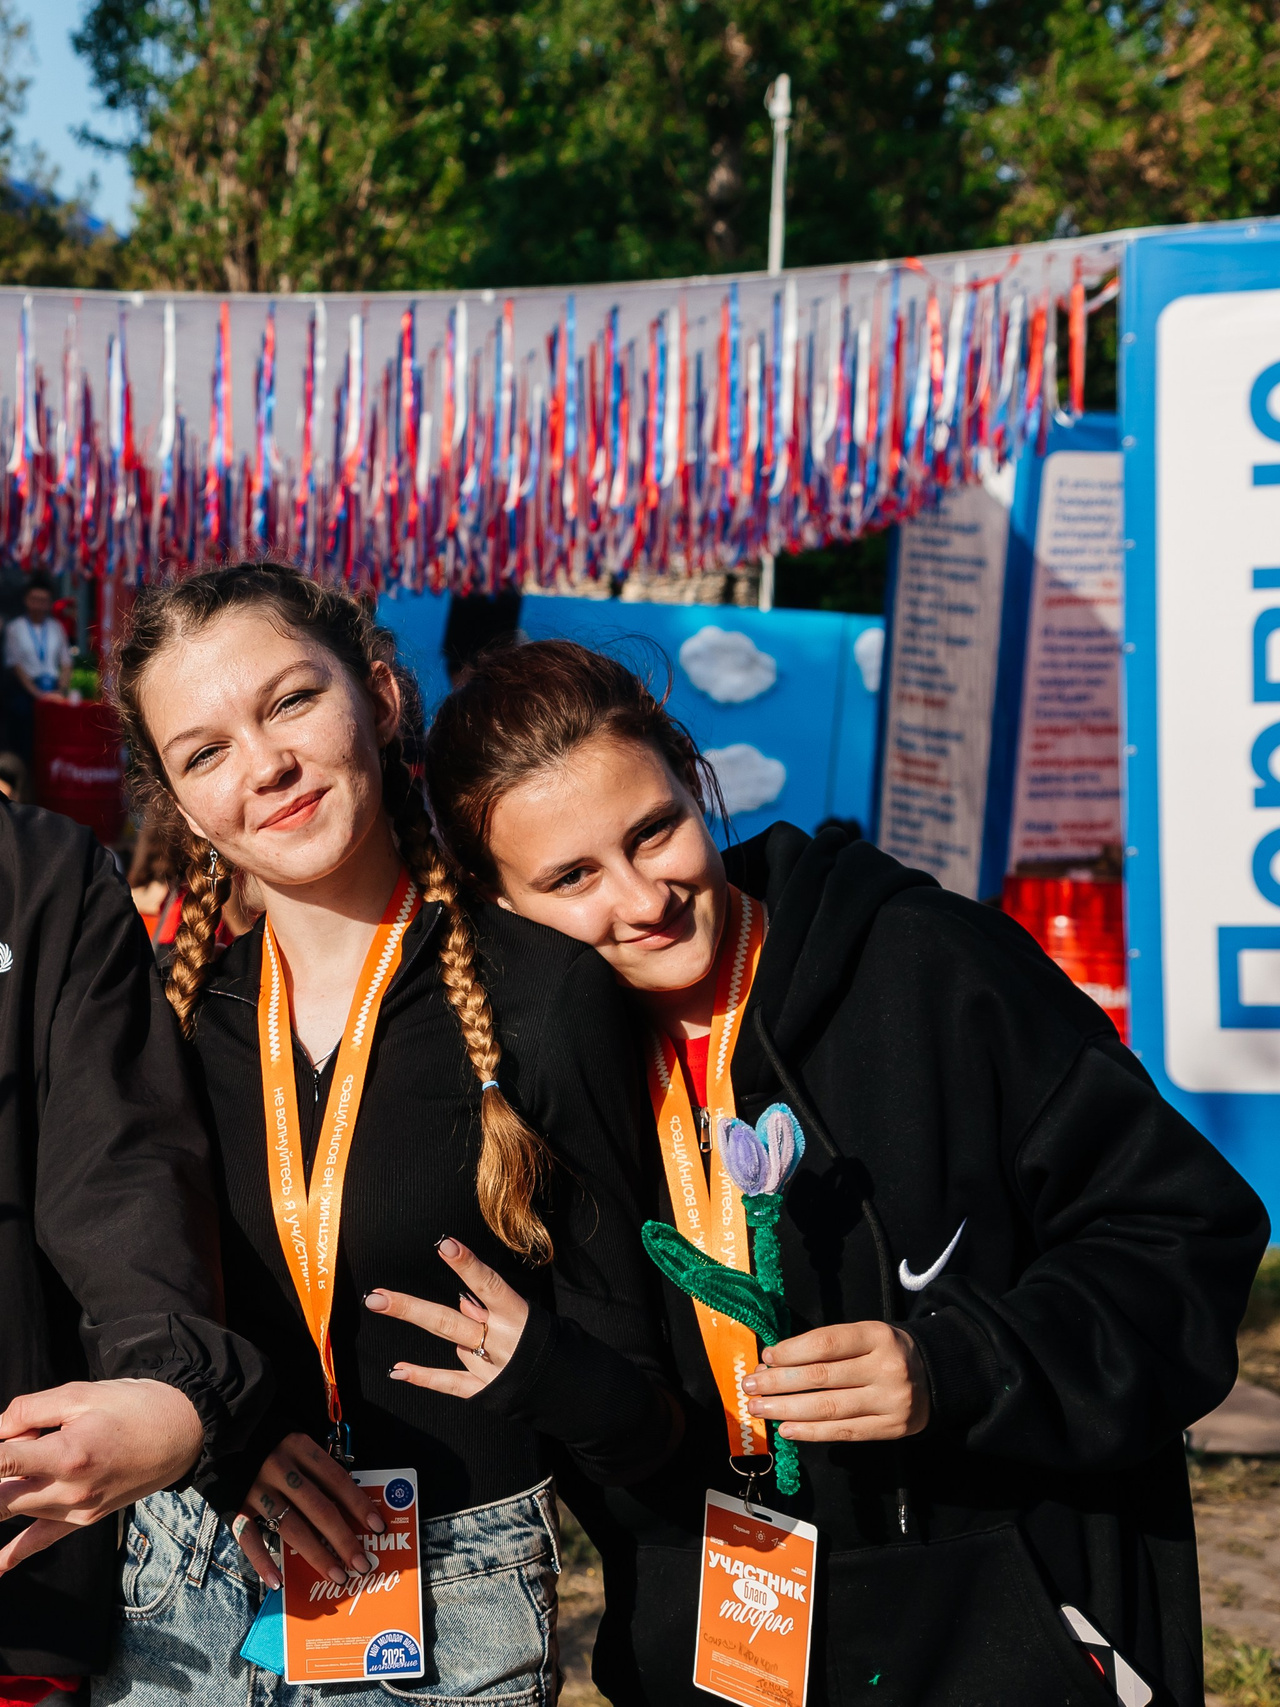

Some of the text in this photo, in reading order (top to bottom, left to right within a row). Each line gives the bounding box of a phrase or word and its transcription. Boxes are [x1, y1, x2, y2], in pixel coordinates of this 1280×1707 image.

[273, 1087, 284, 1106] не
[326, 1074, 354, 1166] волнуйтесь
[275, 1107, 294, 1196] волнуйтесь
[669, 1115, 698, 1207] волнуйтесь
[322, 1167, 334, 1187] не
[687, 1207, 701, 1230] не
[708, 1549, 807, 1604] УЧАСТНИК
[743, 1581, 768, 1606] благо
[382, 1648, 406, 1665] 2025
